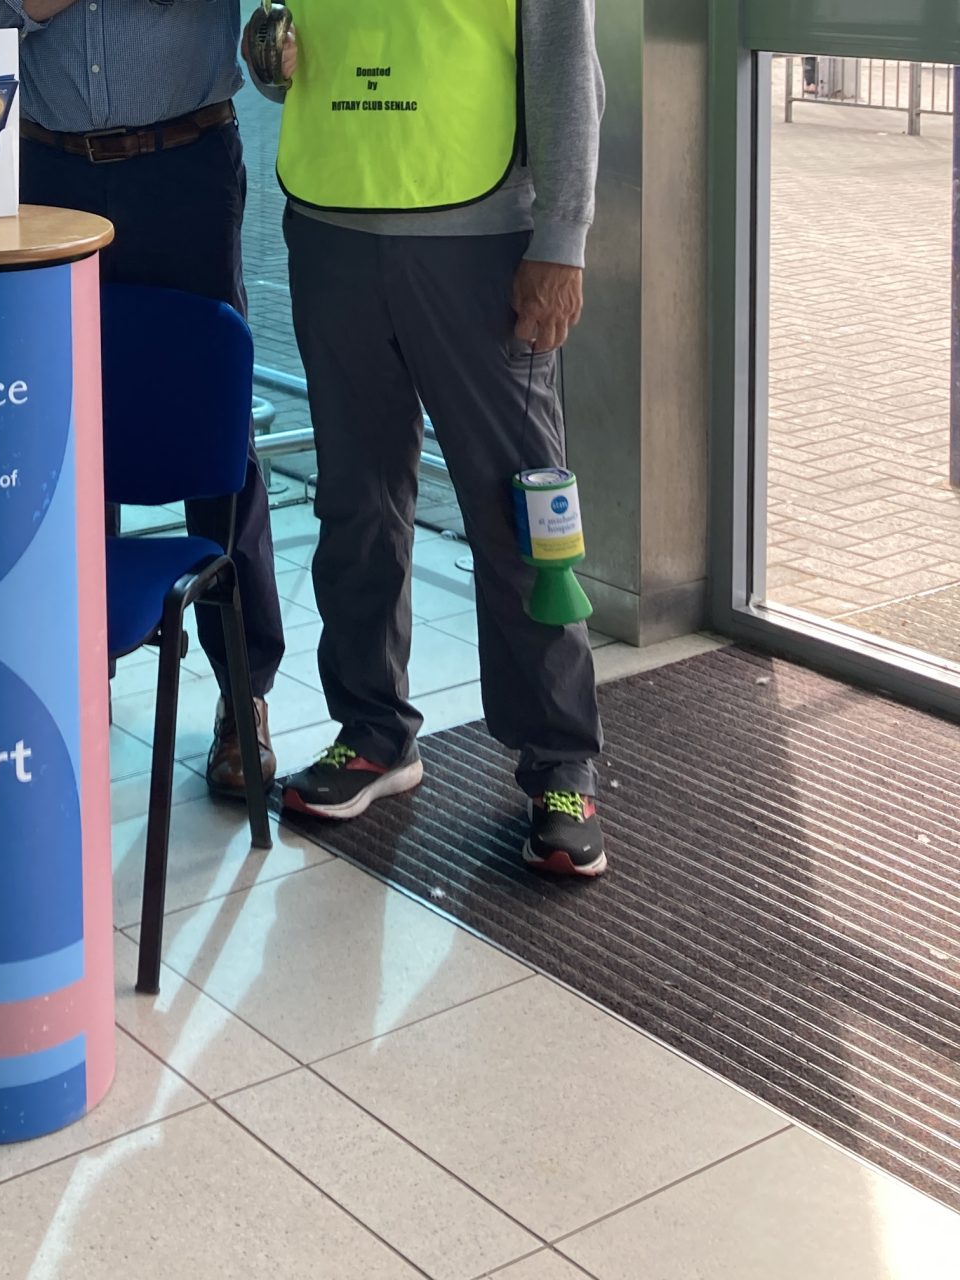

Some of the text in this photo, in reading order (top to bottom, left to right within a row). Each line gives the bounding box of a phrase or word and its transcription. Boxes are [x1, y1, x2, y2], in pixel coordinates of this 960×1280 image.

[356, 67, 391, 77] Donated
[367, 80, 378, 91] by
[331, 101, 418, 111] ROTARY CLUB SENLAC
[0, 469, 18, 488] of
